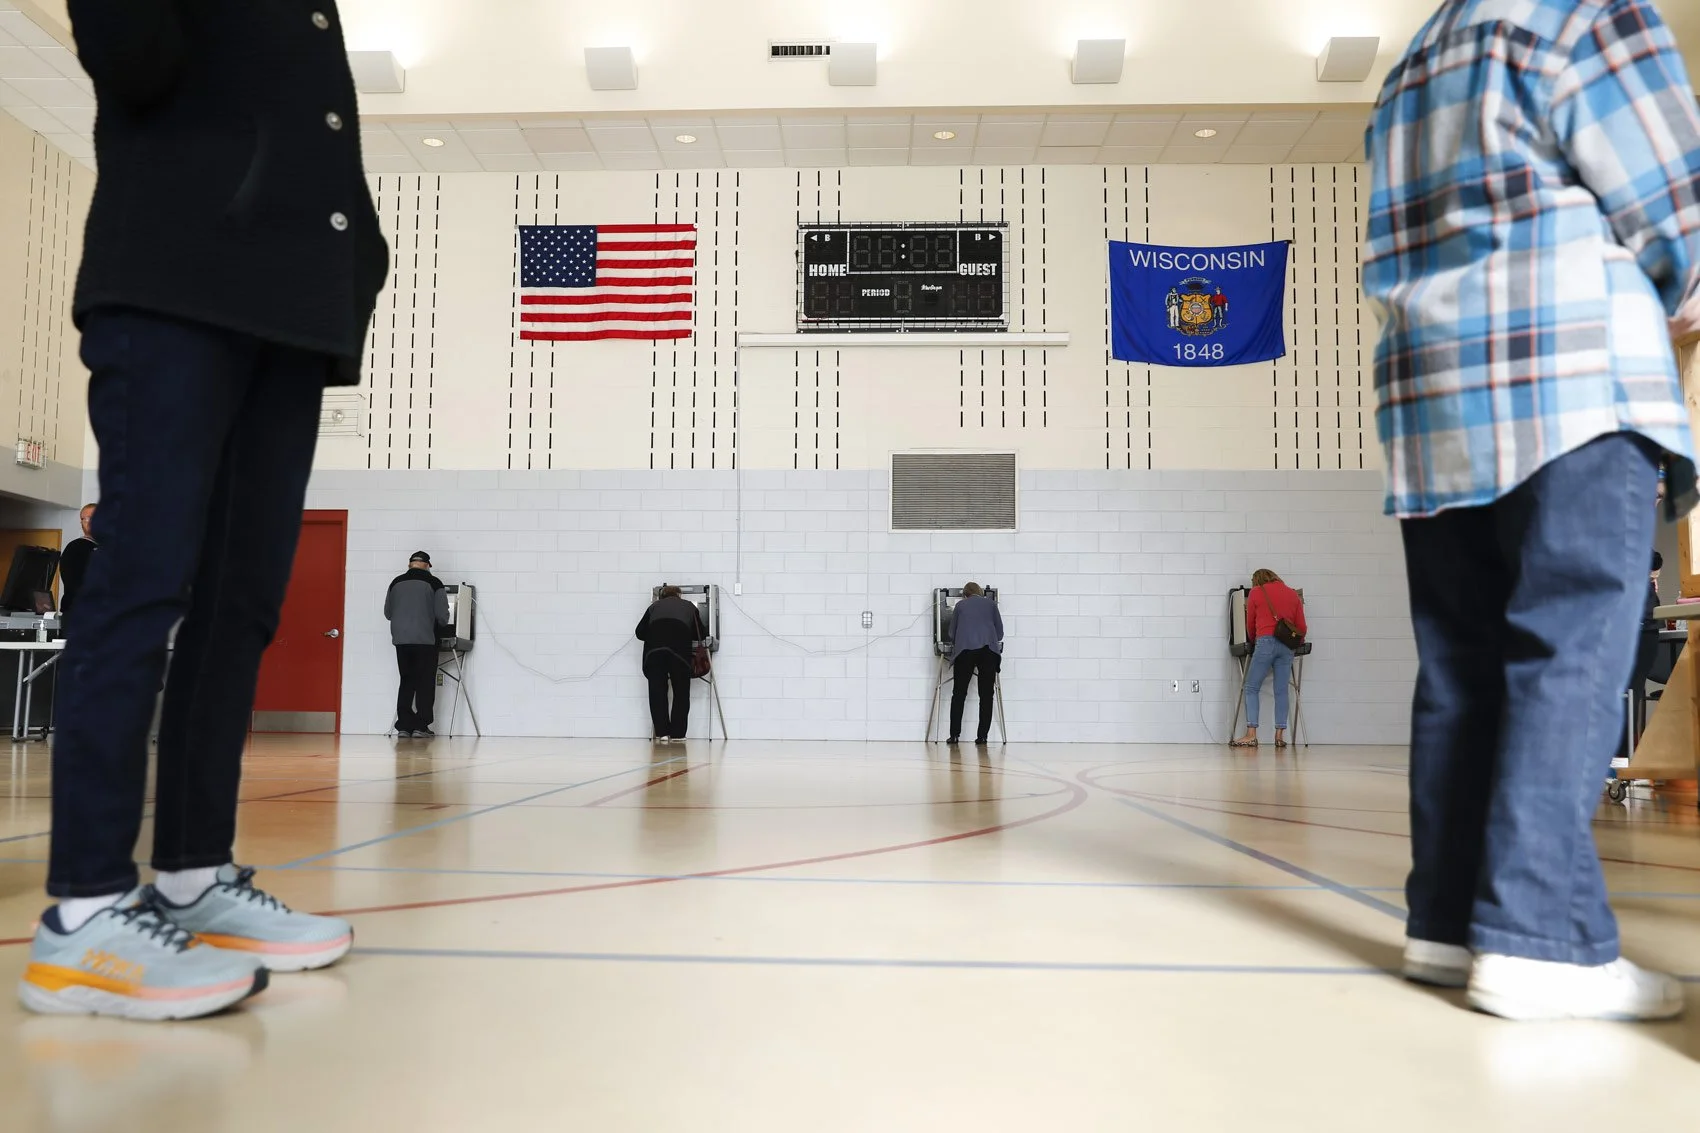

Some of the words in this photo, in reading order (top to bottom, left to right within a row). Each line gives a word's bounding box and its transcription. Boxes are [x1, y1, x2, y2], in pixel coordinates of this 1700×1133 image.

[824, 233, 831, 242] B
[975, 233, 982, 241] B
[1129, 249, 1265, 271] WISCONSIN
[809, 263, 847, 277] HOME
[960, 263, 998, 276] GUEST
[861, 288, 891, 297] PERIOD
[1174, 343, 1224, 360] 1848
